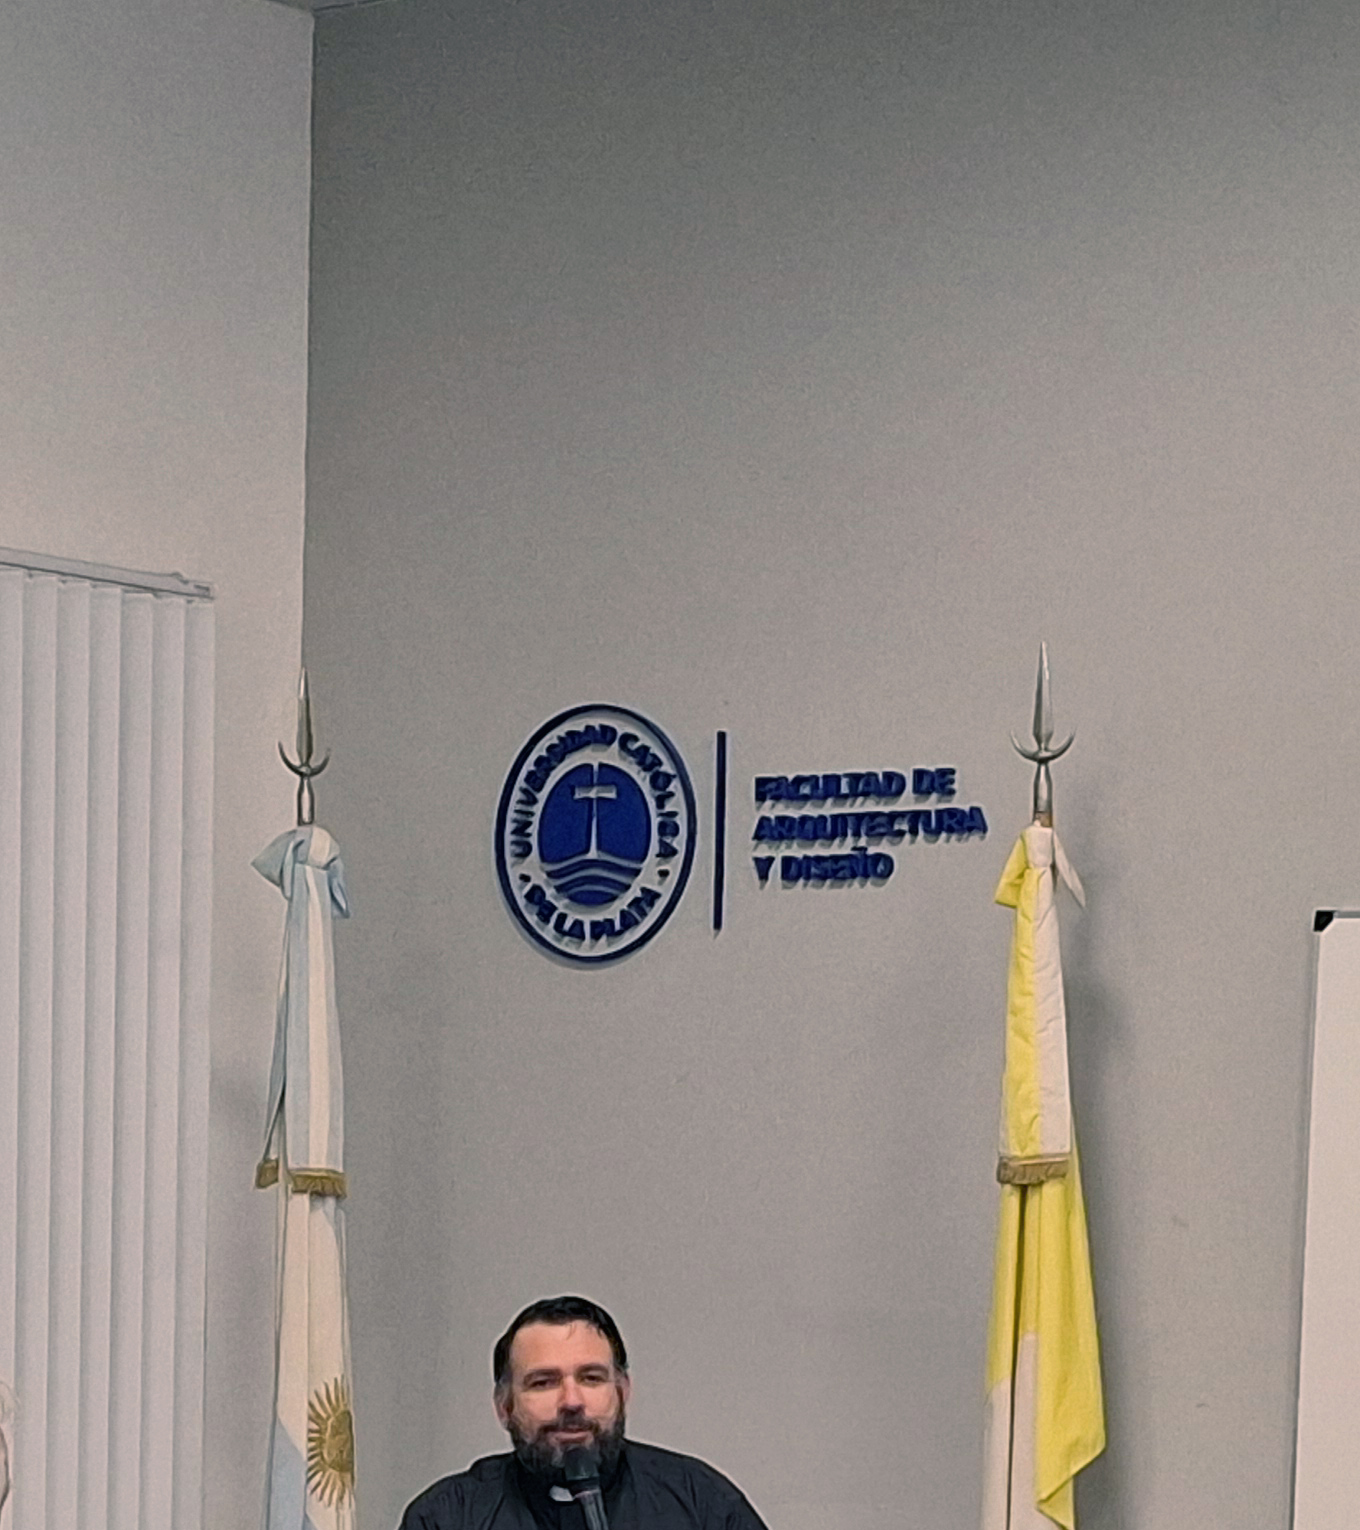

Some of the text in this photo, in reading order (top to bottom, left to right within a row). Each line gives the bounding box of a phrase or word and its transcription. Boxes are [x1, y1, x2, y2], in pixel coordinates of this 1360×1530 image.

[510, 724, 617, 858] UNIVERSIDAD
[755, 768, 956, 801] FACULTAD DE
[752, 806, 988, 840] ARQUITECTURA
[752, 847, 894, 880] Y DISEÑO
[524, 884, 662, 941] DE LA PLATA
